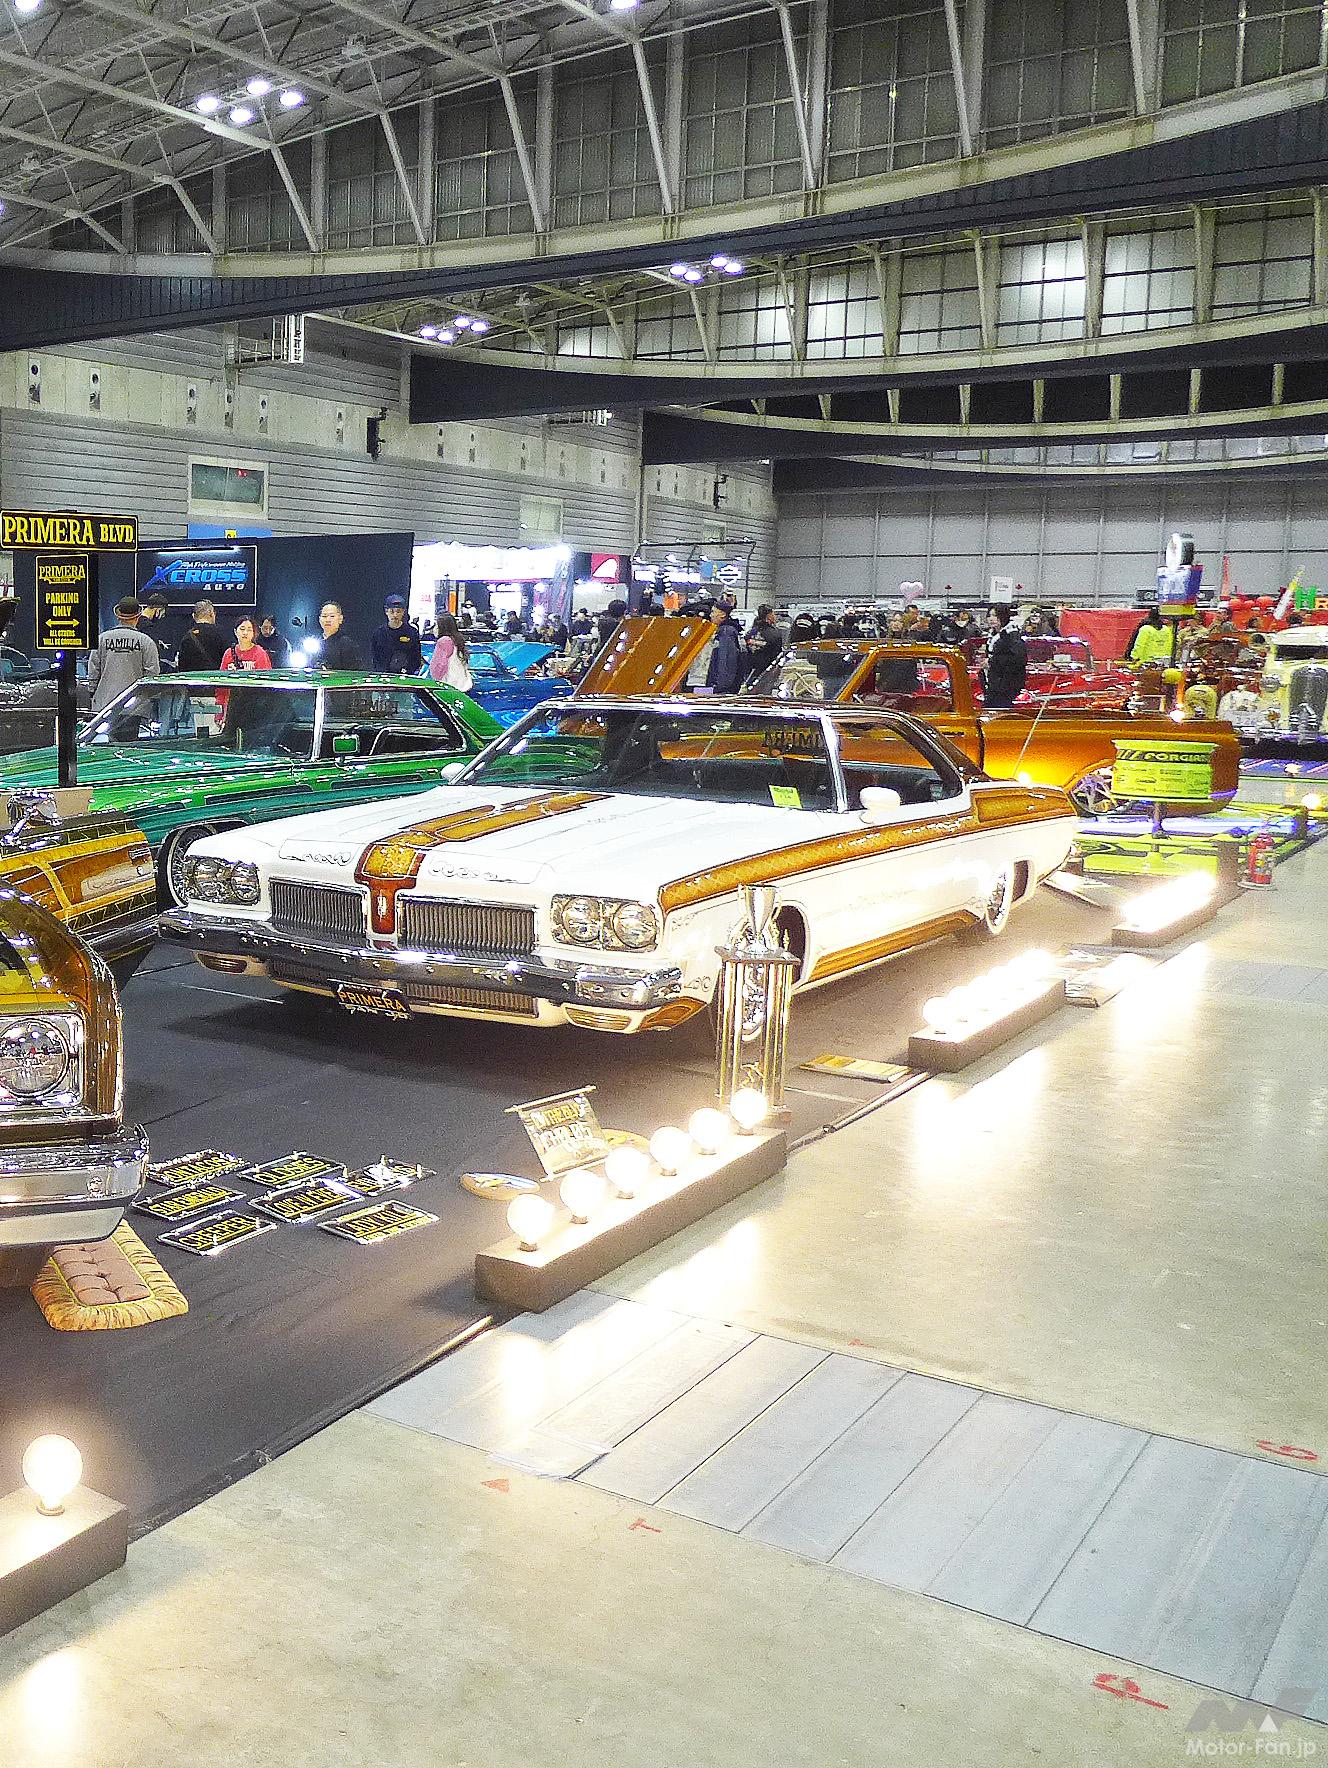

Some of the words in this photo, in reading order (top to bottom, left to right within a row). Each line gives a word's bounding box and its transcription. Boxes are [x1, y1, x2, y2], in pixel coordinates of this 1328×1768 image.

[3, 516, 96, 545] PRIMERA
[100, 524, 135, 543] BLVD.
[39, 565, 86, 579] PRIMERA
[202, 583, 245, 591] AUTO
[45, 593, 79, 604] PARKING
[52, 606, 72, 617] ONLY
[105, 637, 141, 651] FAMILIA
[338, 991, 407, 1011] PRIMERA
[176, 1216, 257, 1249] CREEPER
